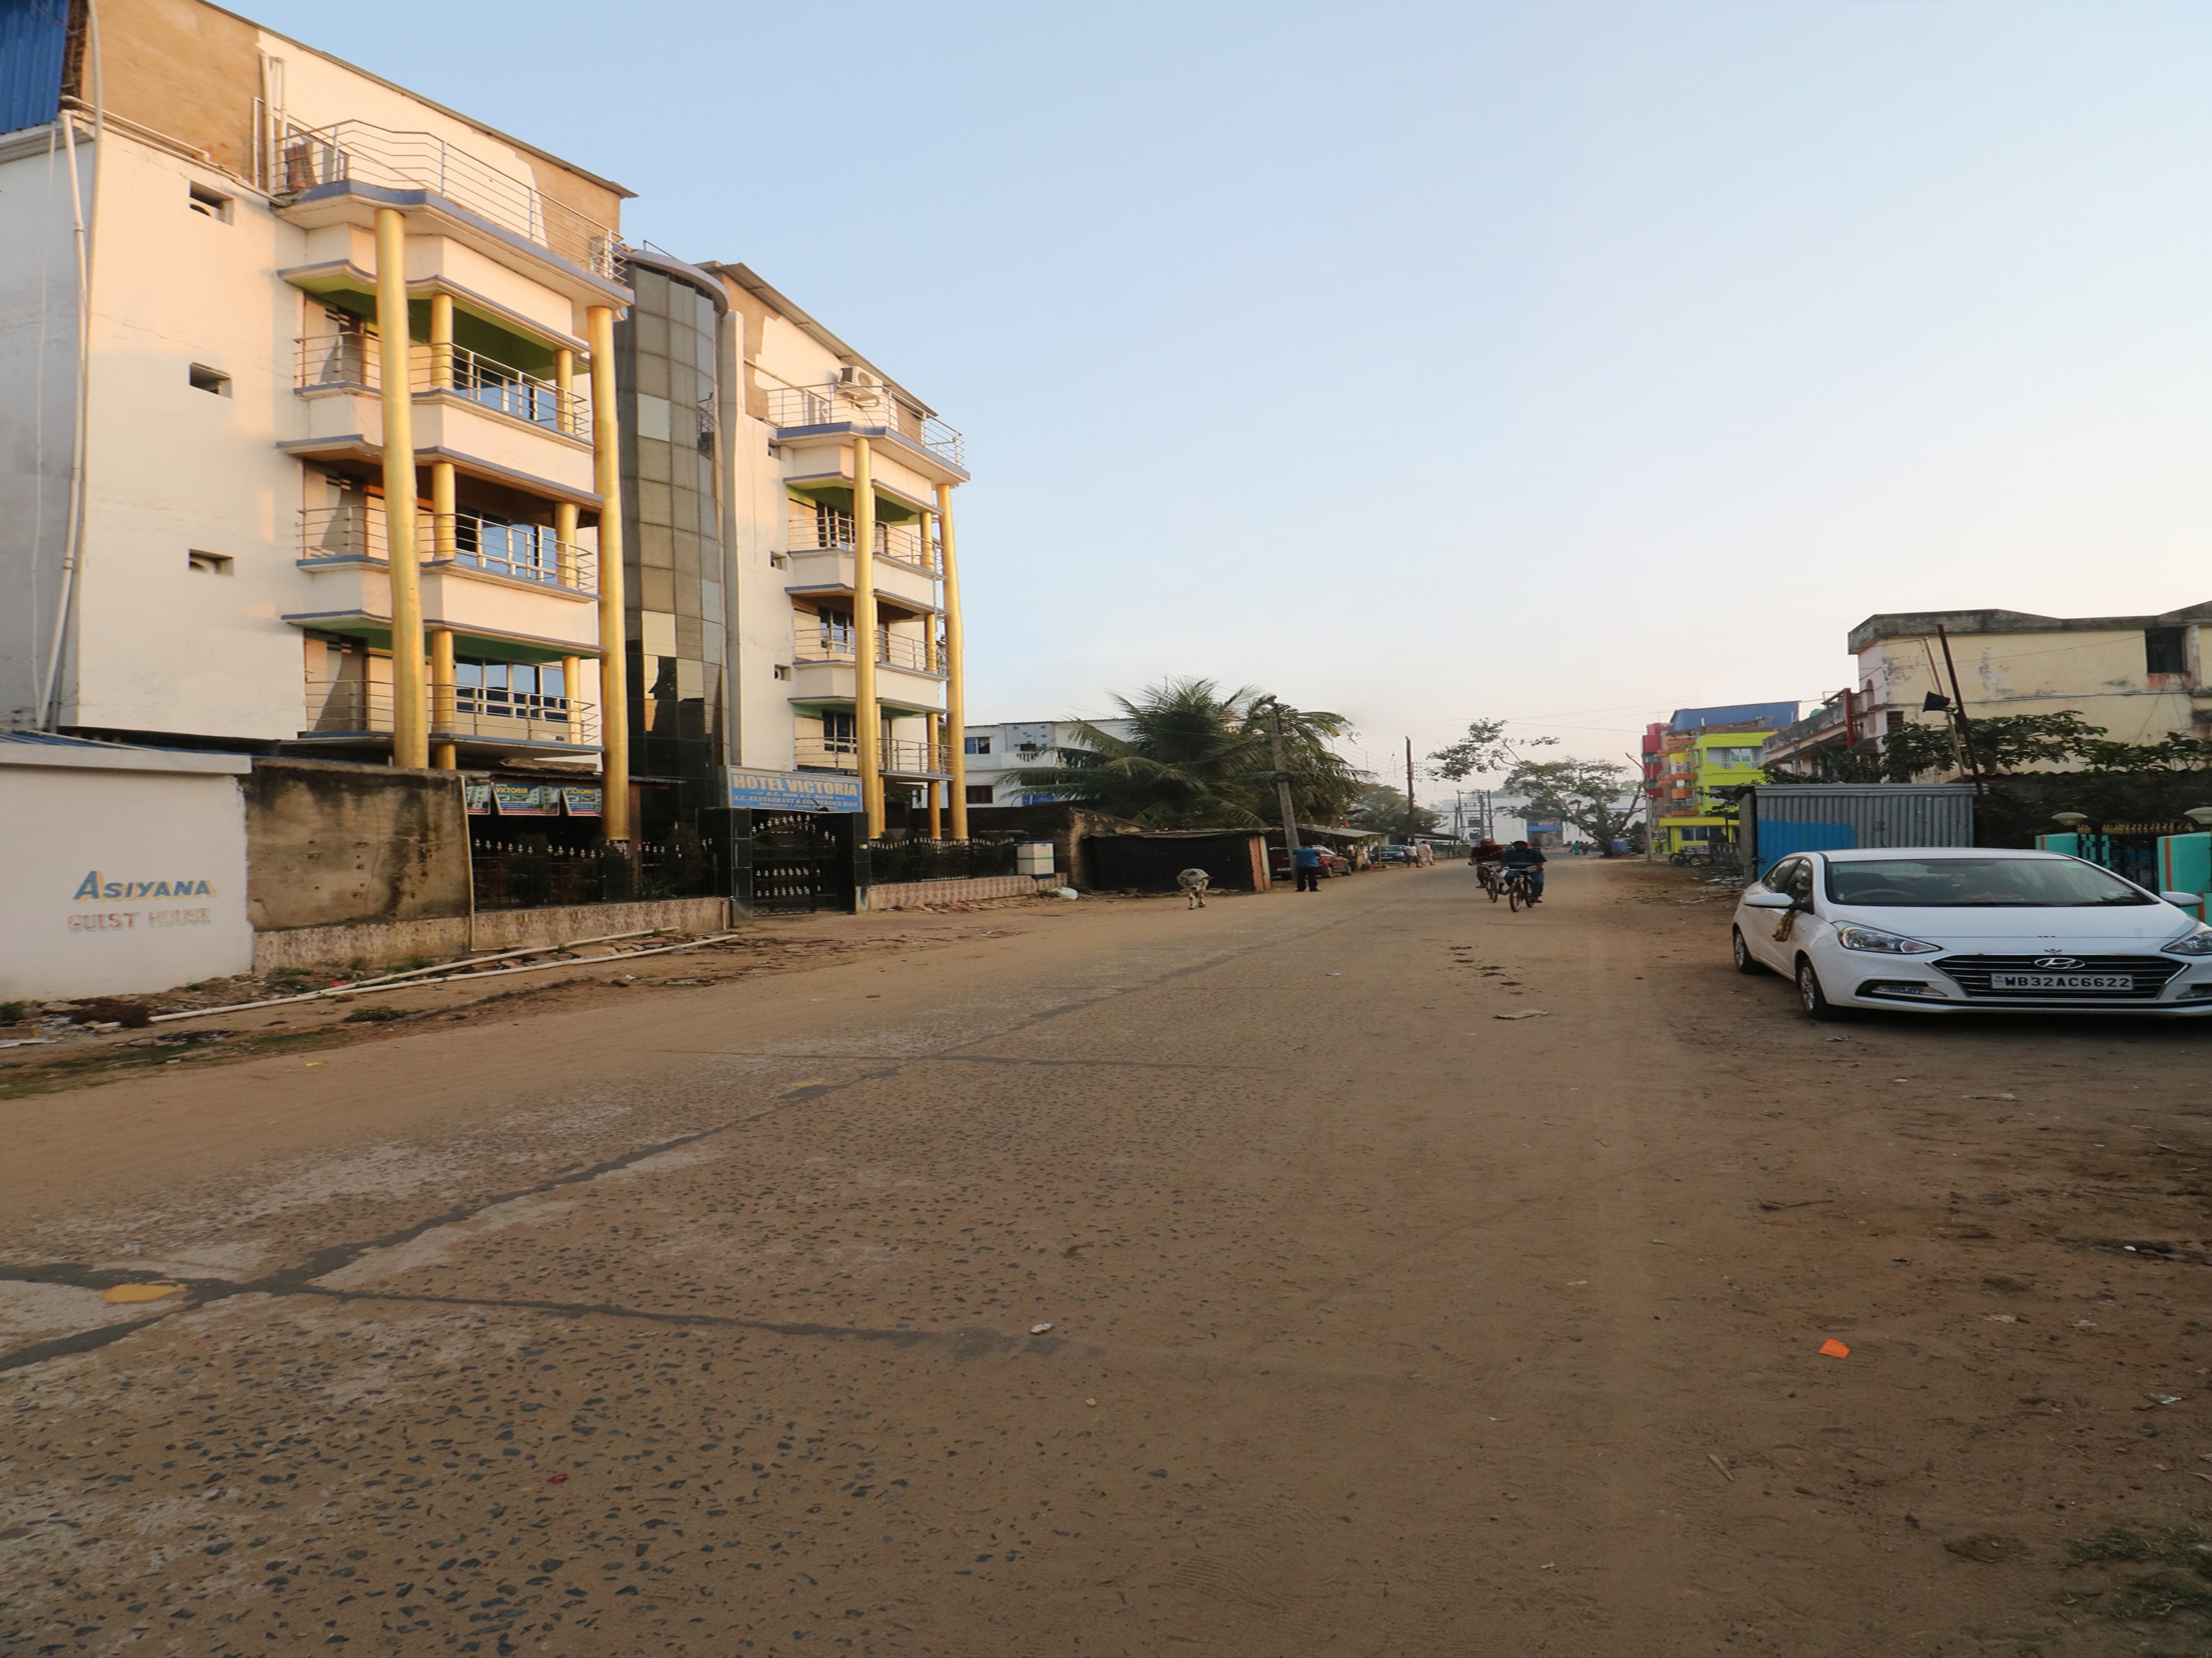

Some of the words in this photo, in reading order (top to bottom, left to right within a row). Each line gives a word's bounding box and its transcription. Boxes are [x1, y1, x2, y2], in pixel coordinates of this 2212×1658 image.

[732, 774, 785, 792] HOTEL
[786, 779, 858, 797] VICTORIA
[73, 870, 216, 902] ASIYANA
[68, 911, 140, 933] GUEST
[148, 907, 212, 928] HOUSE
[2005, 977, 2131, 988] WB32AC6622
